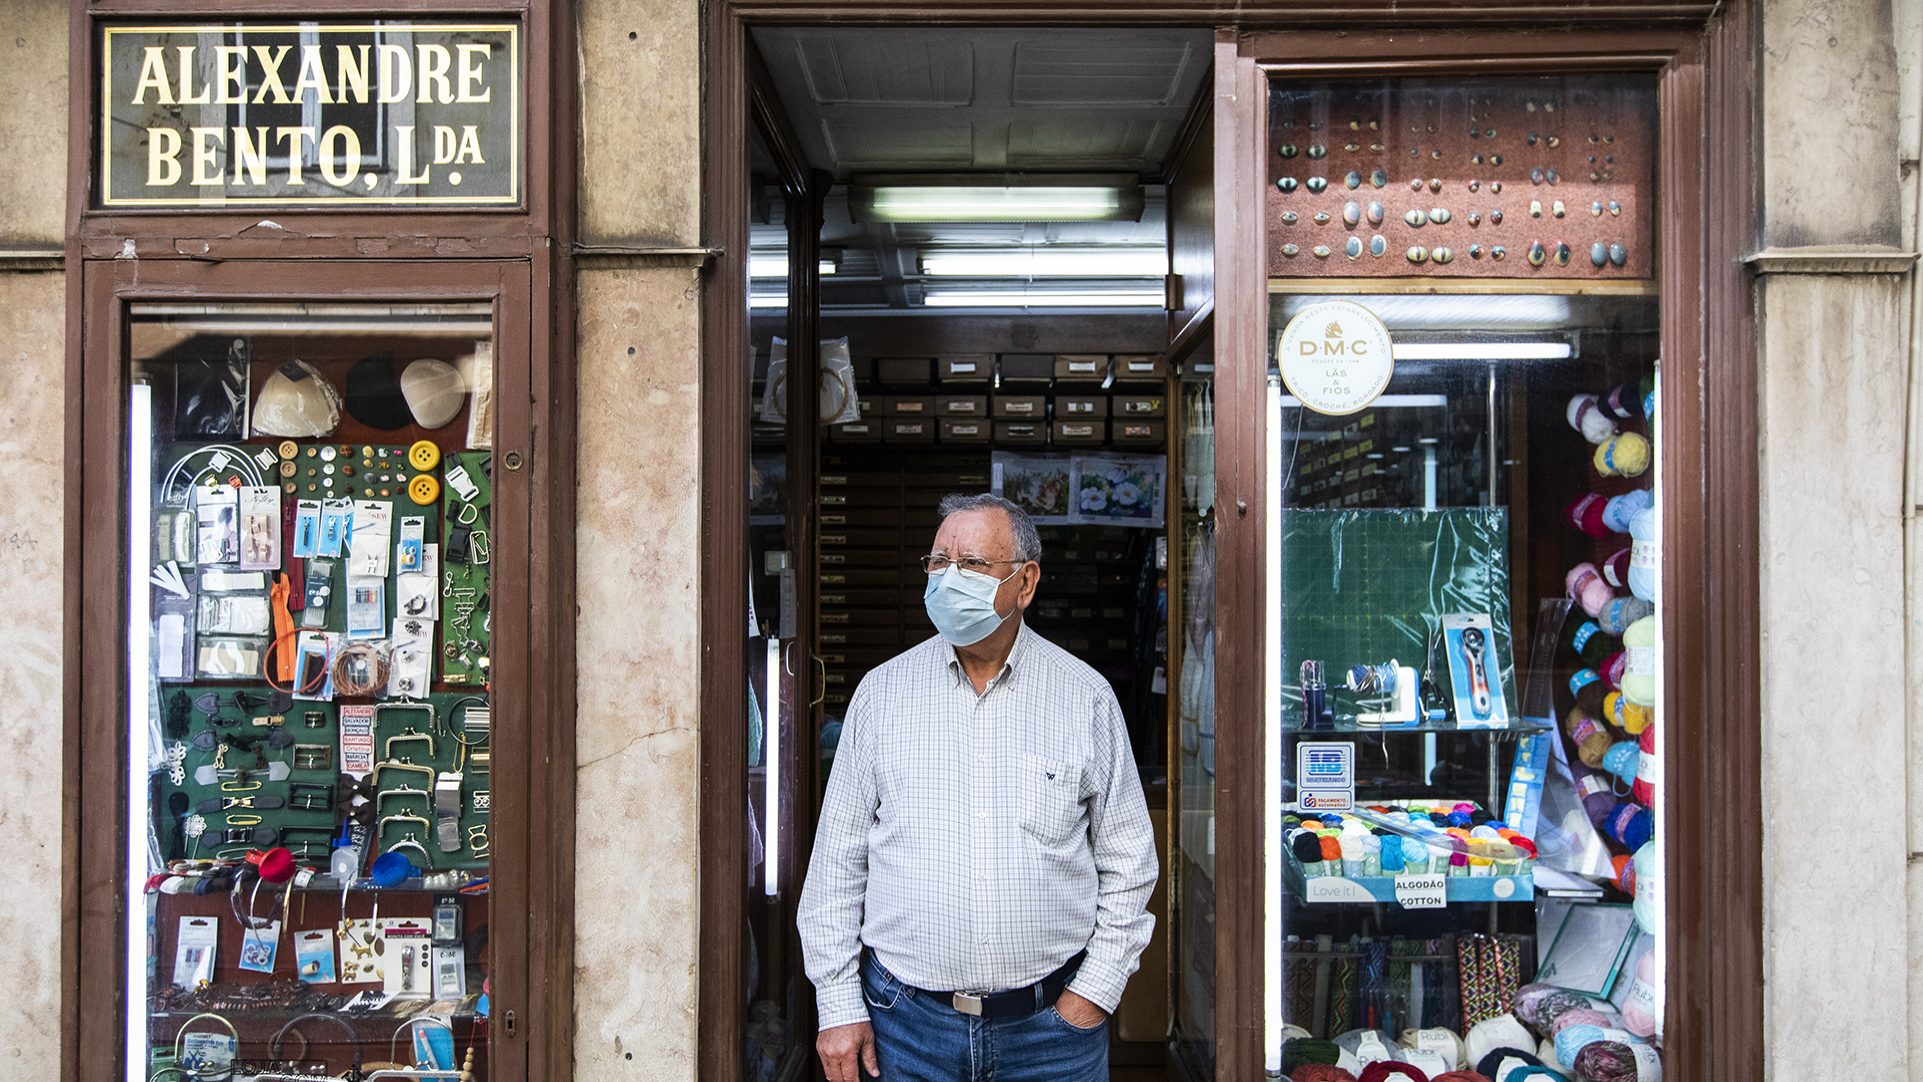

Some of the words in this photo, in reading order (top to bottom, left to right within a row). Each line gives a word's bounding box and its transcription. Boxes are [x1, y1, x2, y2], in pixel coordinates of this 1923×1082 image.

[131, 44, 492, 105] ALEXANDRE
[145, 125, 378, 191] BENTO,
[1322, 386, 1351, 395] FIOS
[1395, 880, 1445, 890] ALGODÃO
[1312, 886, 1341, 898] Love
[1400, 896, 1442, 907] COTTON
